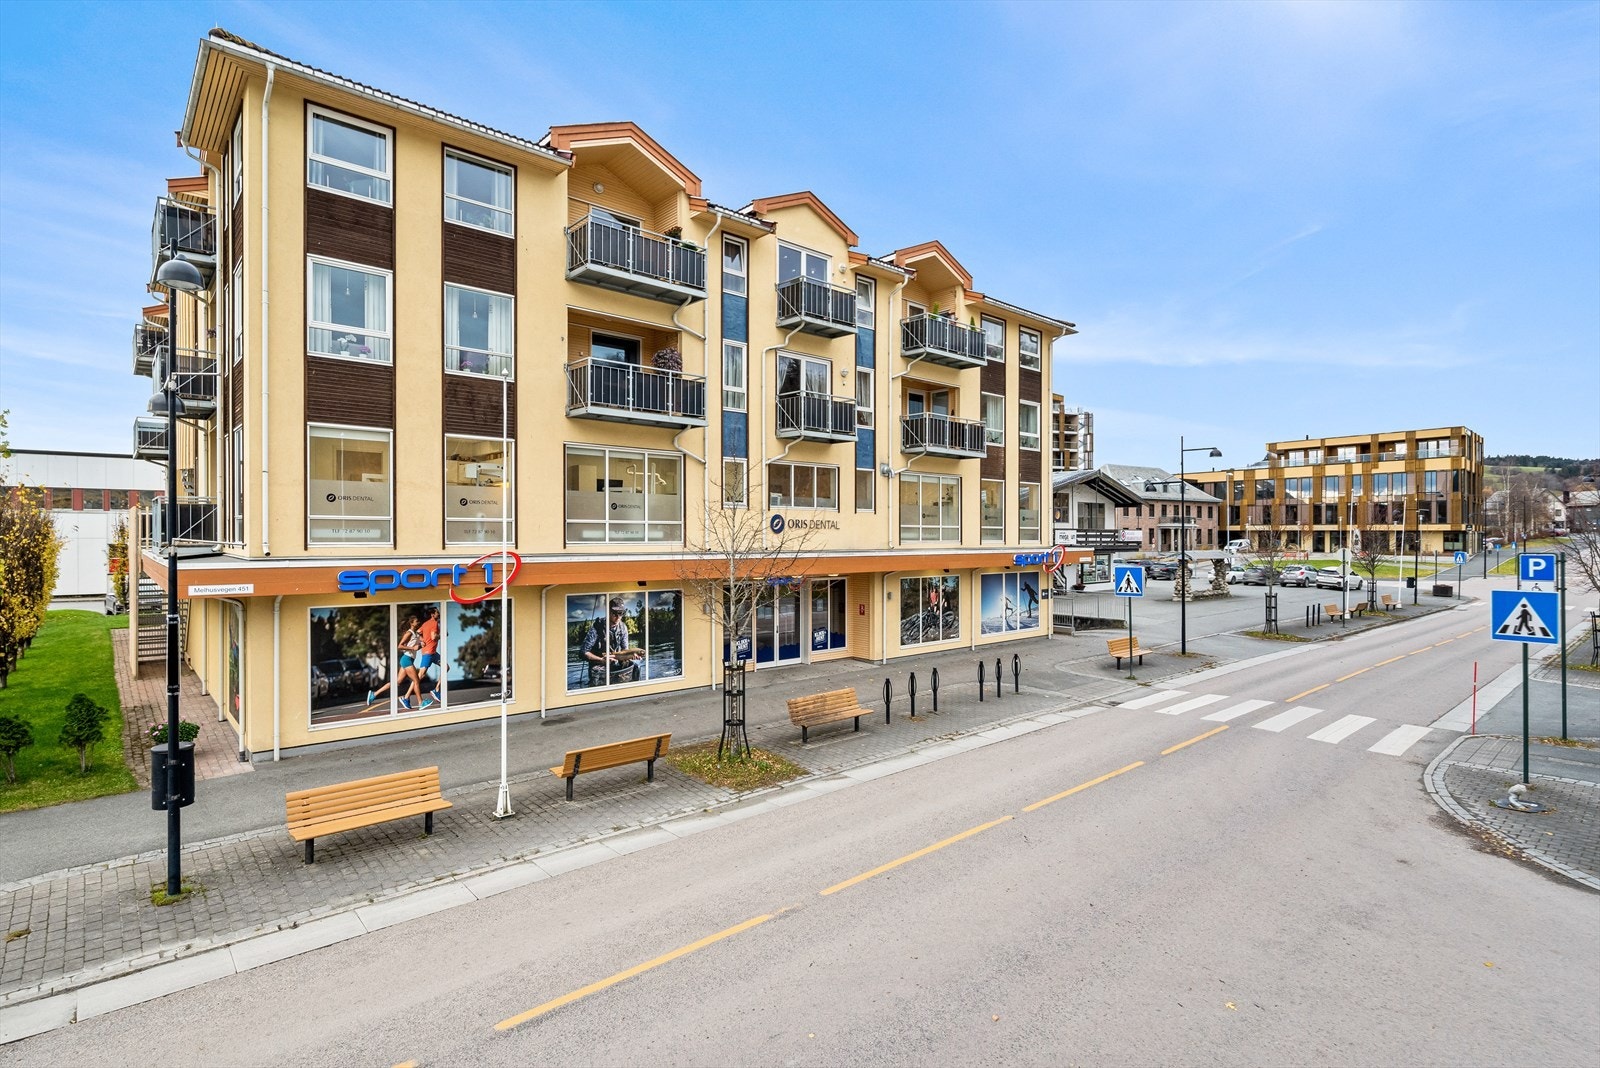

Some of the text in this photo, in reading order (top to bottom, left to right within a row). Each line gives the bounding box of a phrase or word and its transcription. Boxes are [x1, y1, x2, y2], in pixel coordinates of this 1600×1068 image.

[788, 519, 840, 530] ORIS DENTAL
[1528, 558, 1546, 578] P
[338, 562, 494, 596] sport 1
